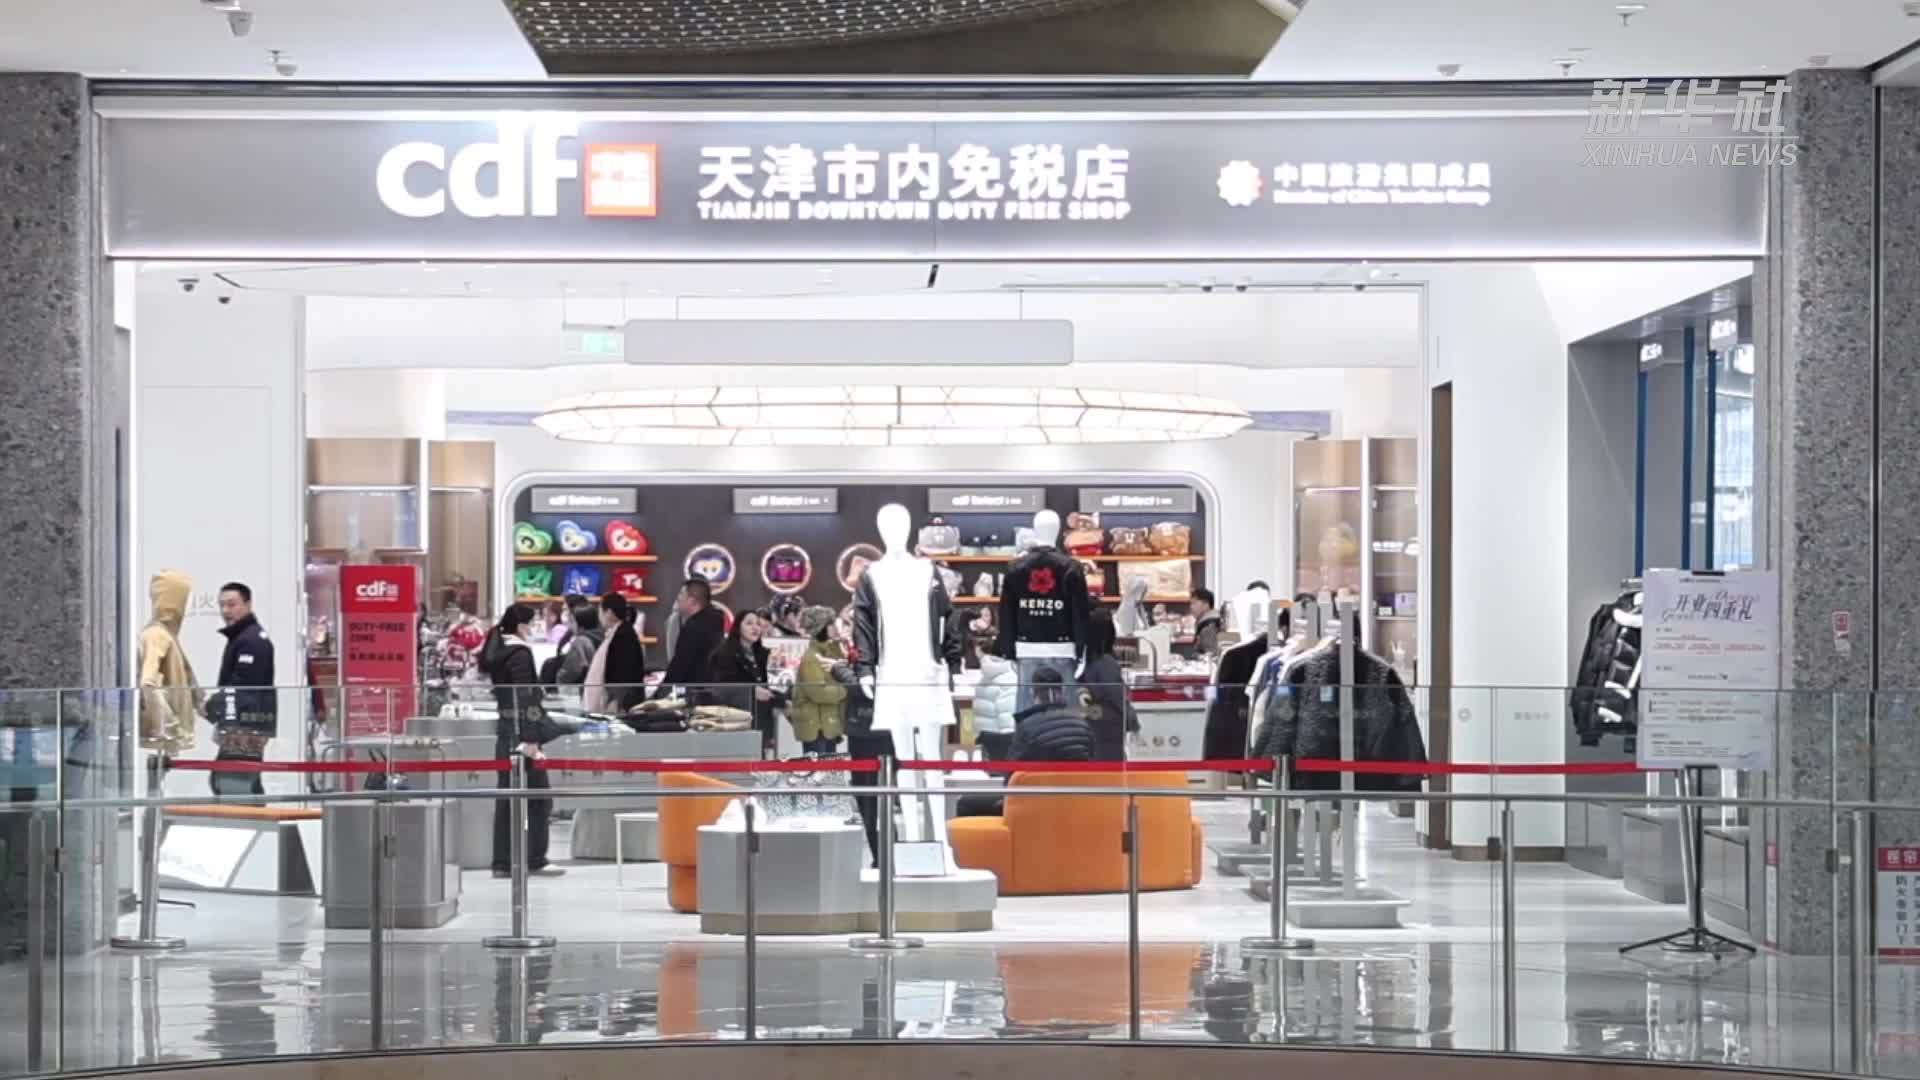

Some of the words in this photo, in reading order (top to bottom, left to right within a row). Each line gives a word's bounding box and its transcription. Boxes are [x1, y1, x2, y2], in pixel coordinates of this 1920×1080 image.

[377, 111, 577, 217] cdf
[698, 143, 1129, 200] 天津市内免税店
[697, 200, 791, 220] TIANJIN
[798, 200, 931, 220] DOWNTOWN
[937, 201, 998, 220] DUTY
[1004, 201, 1062, 220] FREE
[1067, 201, 1132, 220] SHOP
[355, 580, 387, 597] cdf
[1019, 598, 1065, 610] KENZO
